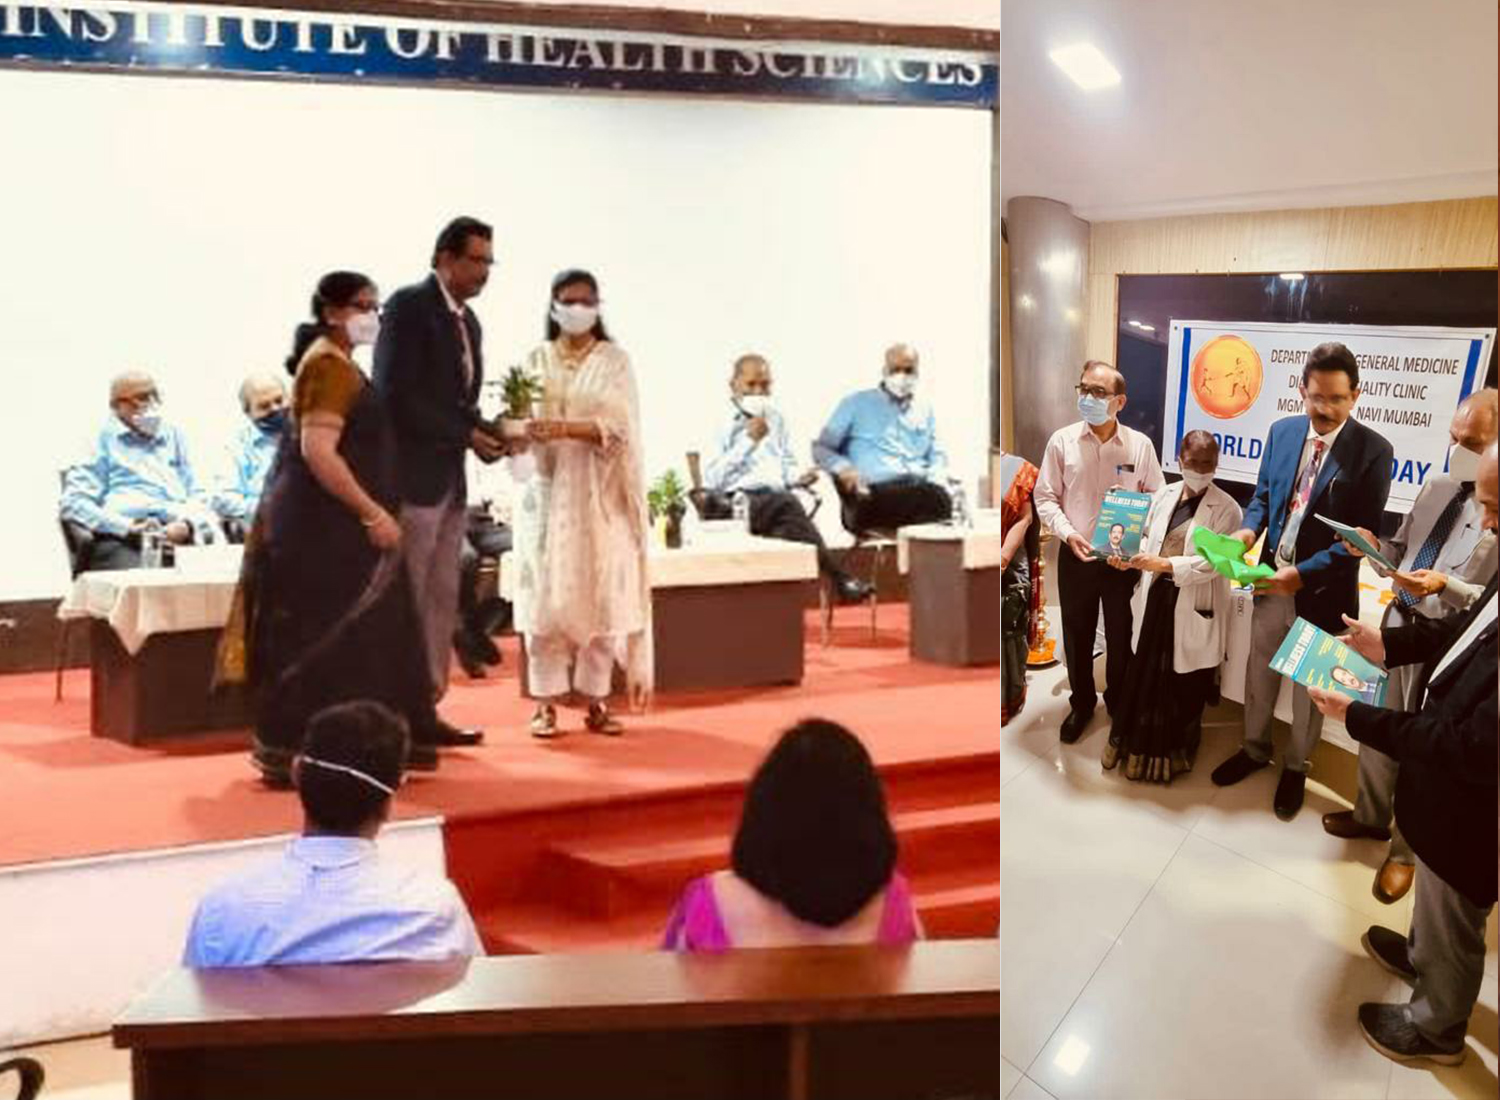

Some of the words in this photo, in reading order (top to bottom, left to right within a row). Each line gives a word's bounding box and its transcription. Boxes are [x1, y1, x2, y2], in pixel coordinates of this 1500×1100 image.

[1271, 349, 1312, 364] DEPART
[1355, 354, 1400, 371] GENERAL
[1403, 357, 1459, 375] MEDICINE
[1393, 383, 1428, 400] CLINIC
[1277, 398, 1304, 413] MGM
[1356, 406, 1381, 422] NAVI
[1383, 408, 1432, 428] MUMBAI
